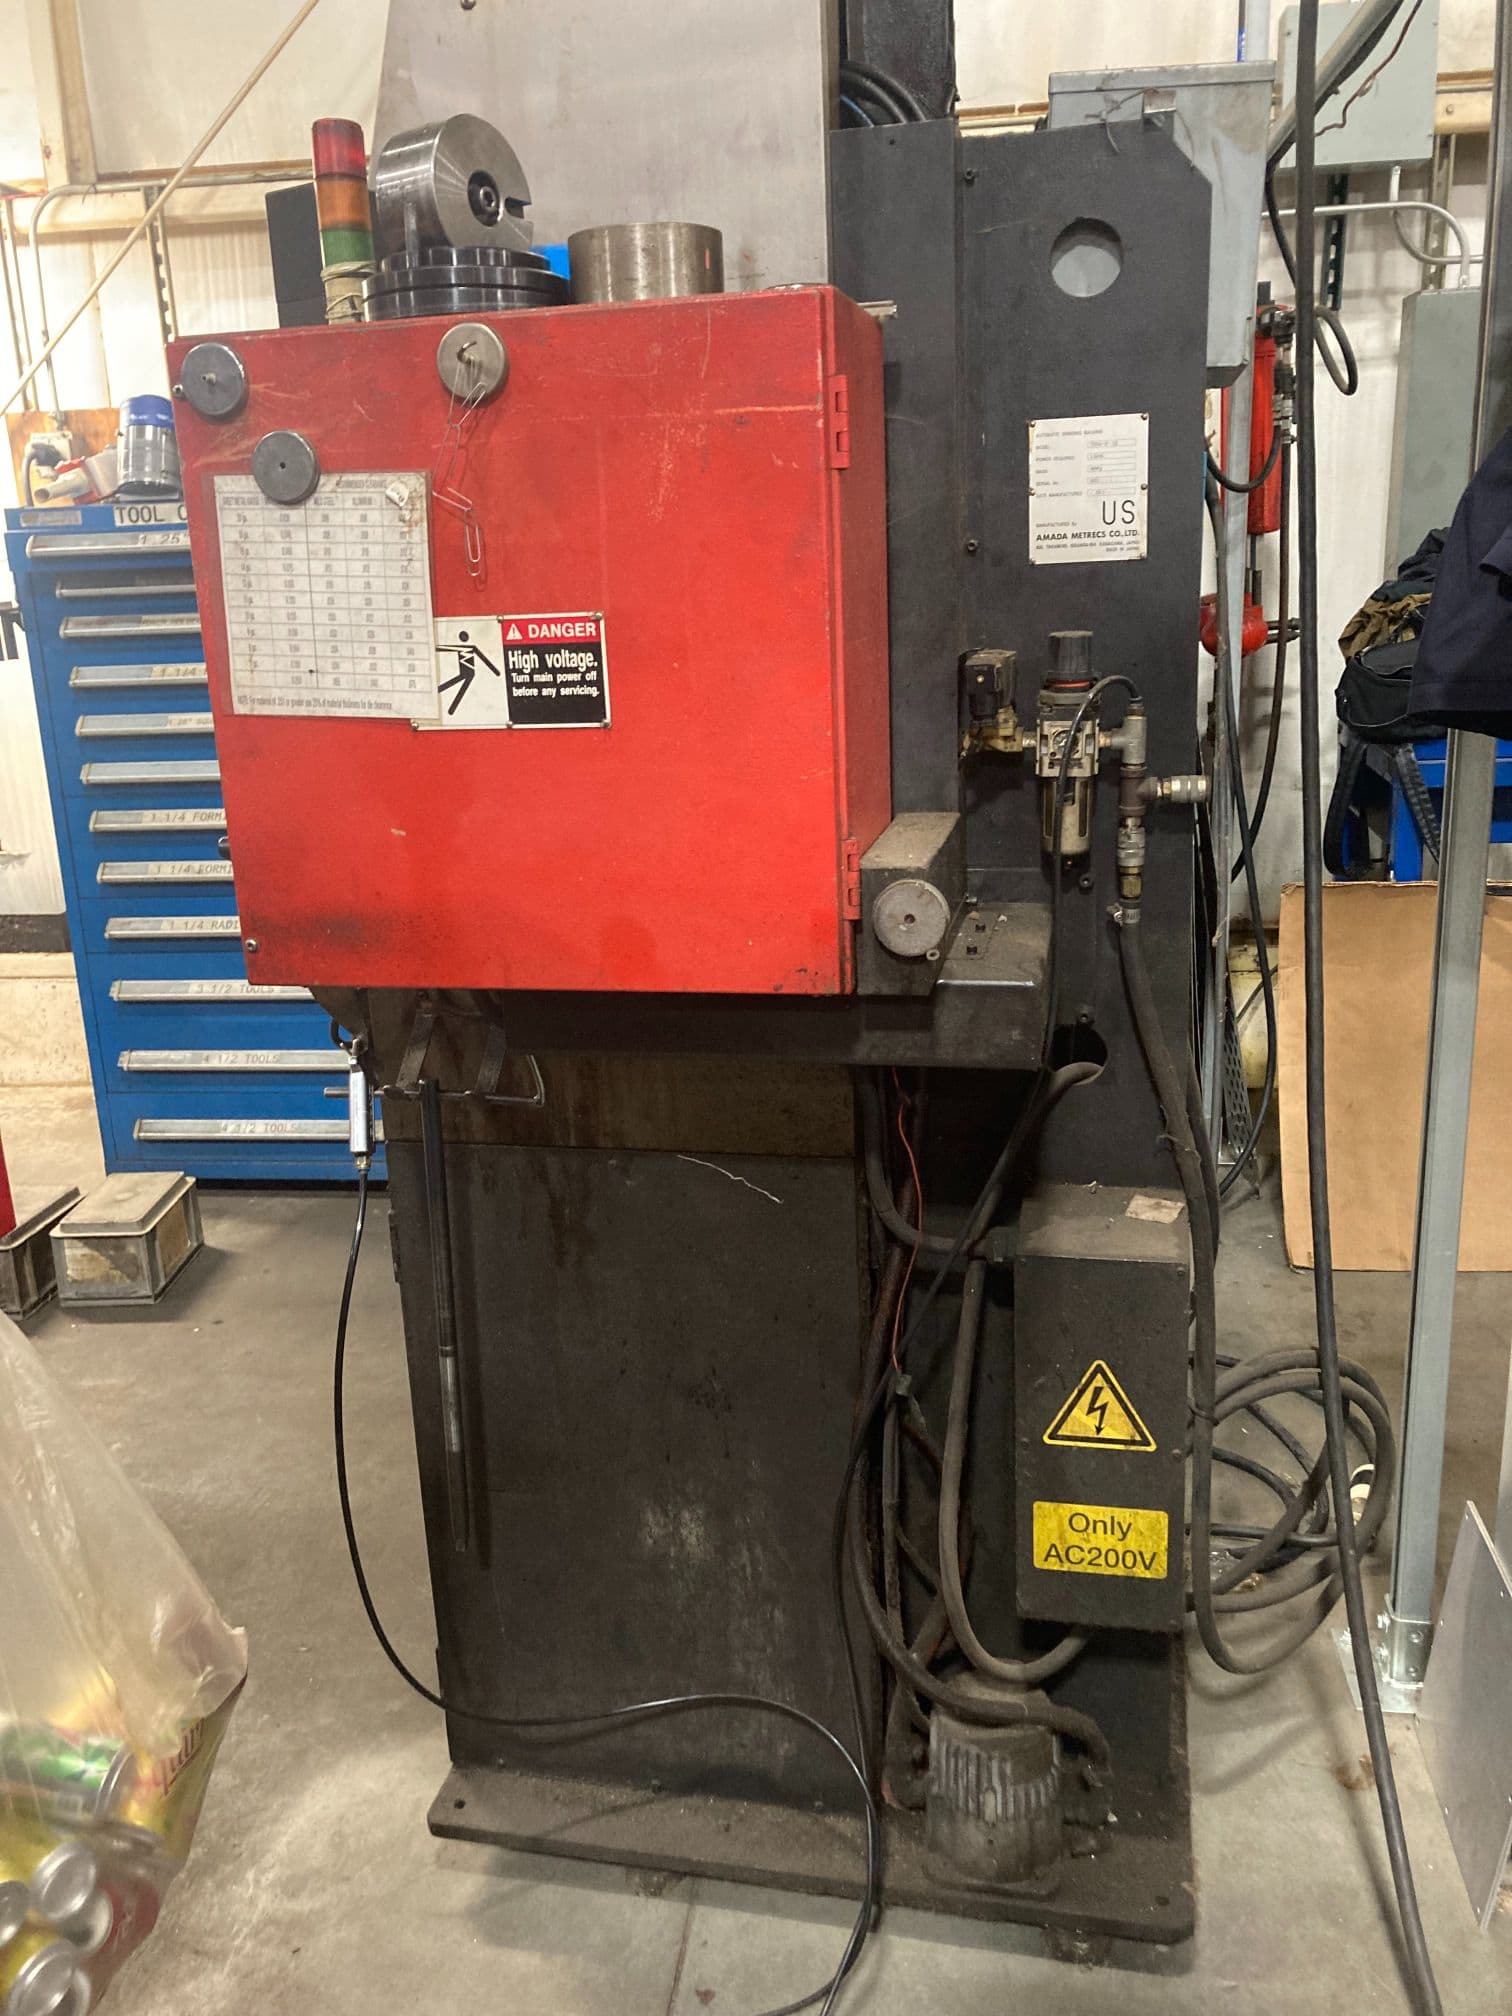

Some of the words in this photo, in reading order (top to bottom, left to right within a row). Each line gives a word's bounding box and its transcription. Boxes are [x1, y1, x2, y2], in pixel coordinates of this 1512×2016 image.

[115, 505, 165, 524] TOOL
[1102, 499, 1136, 526] US
[1036, 533, 1068, 542] AMADA
[1071, 530, 1107, 540] METRECS
[527, 621, 597, 639] DANGER
[508, 649, 540, 674] High
[544, 648, 599, 672] voltage.
[510, 672, 531, 683] Turn
[533, 671, 554, 682] main
[556, 672, 582, 684] power
[585, 670, 598, 681] off
[511, 685, 539, 697] before
[541, 686, 557, 699] any
[560, 684, 601, 698] servicing.
[165, 811, 186, 823] 1/4
[170, 864, 191, 875] 1/4
[183, 919, 204, 929] 1/4
[211, 983, 233, 994] 1/2
[218, 1053, 238, 1064] 1/2
[244, 1053, 280, 1064] TOOLS
[262, 1123, 297, 1133] TOOLS
[1068, 1512, 1133, 1542] Only
[1043, 1543, 1159, 1571] AC200V
